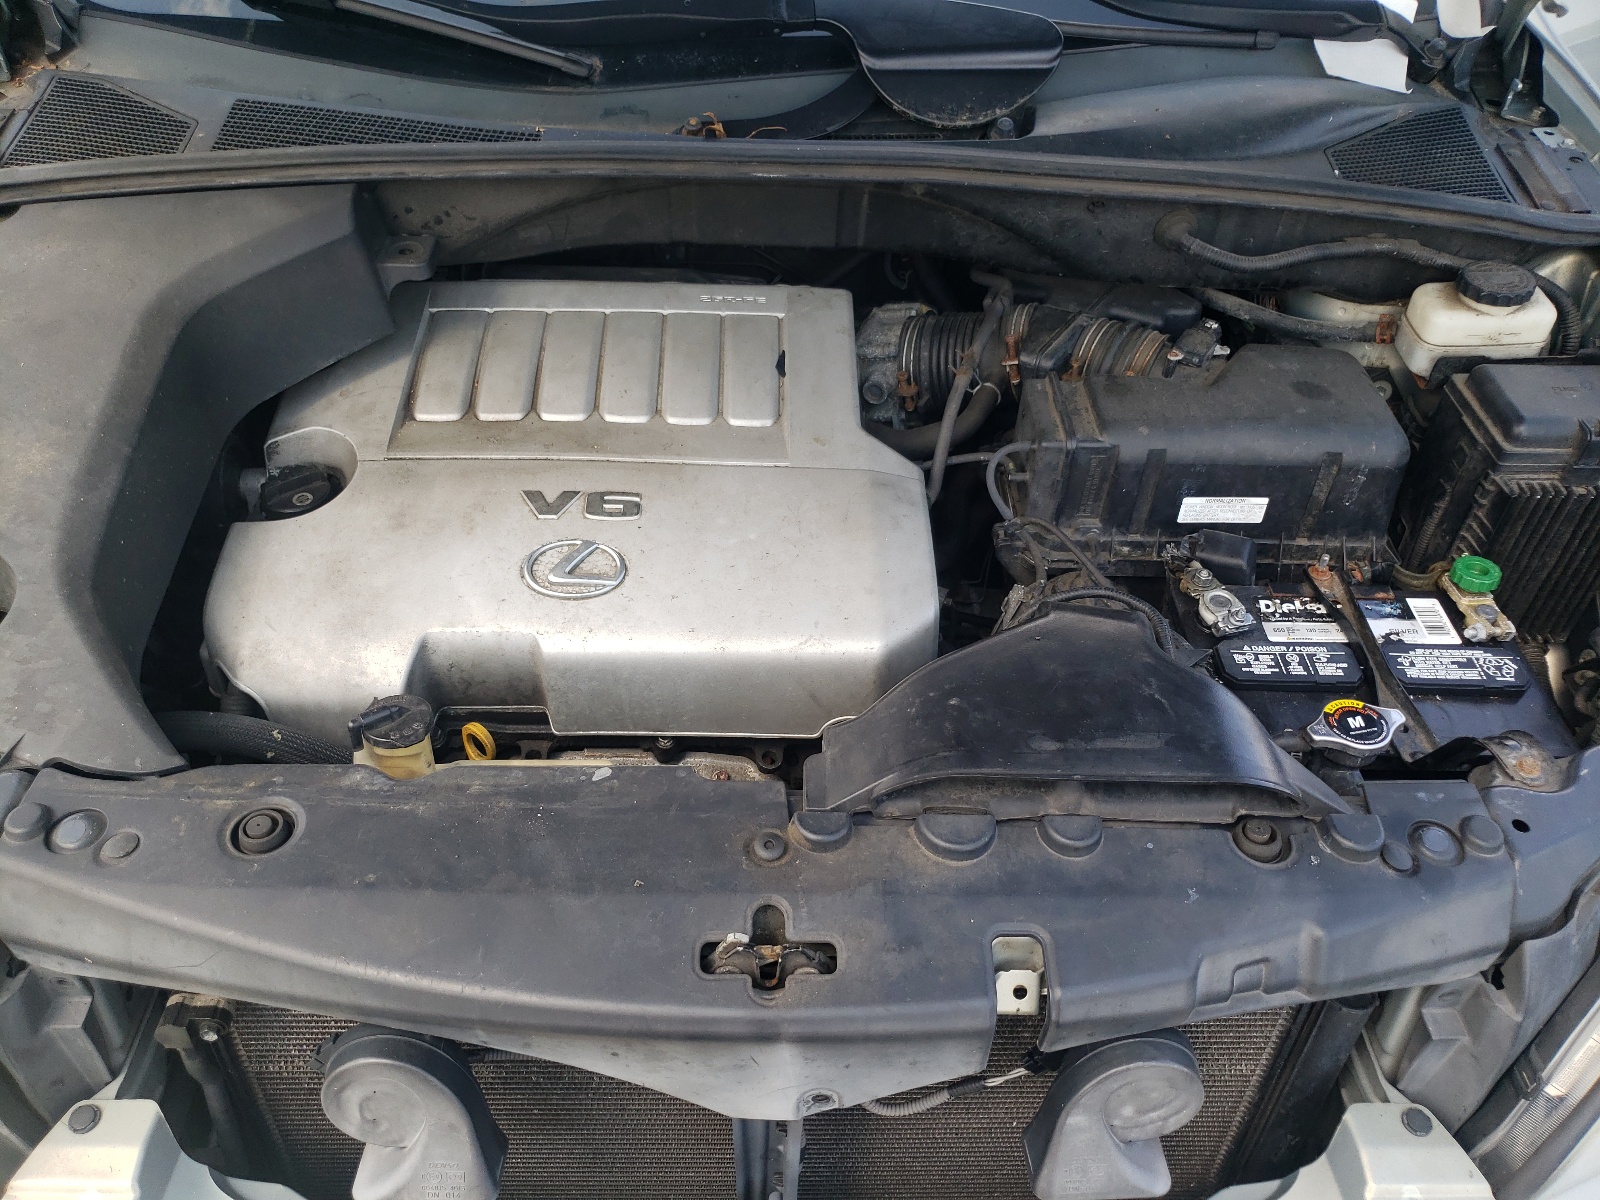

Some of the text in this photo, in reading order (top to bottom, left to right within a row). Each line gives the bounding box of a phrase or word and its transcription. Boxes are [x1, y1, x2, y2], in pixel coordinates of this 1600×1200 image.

[520, 490, 642, 520] V6
[1330, 701, 1361, 709] CAUTION
[1347, 715, 1365, 729] M
